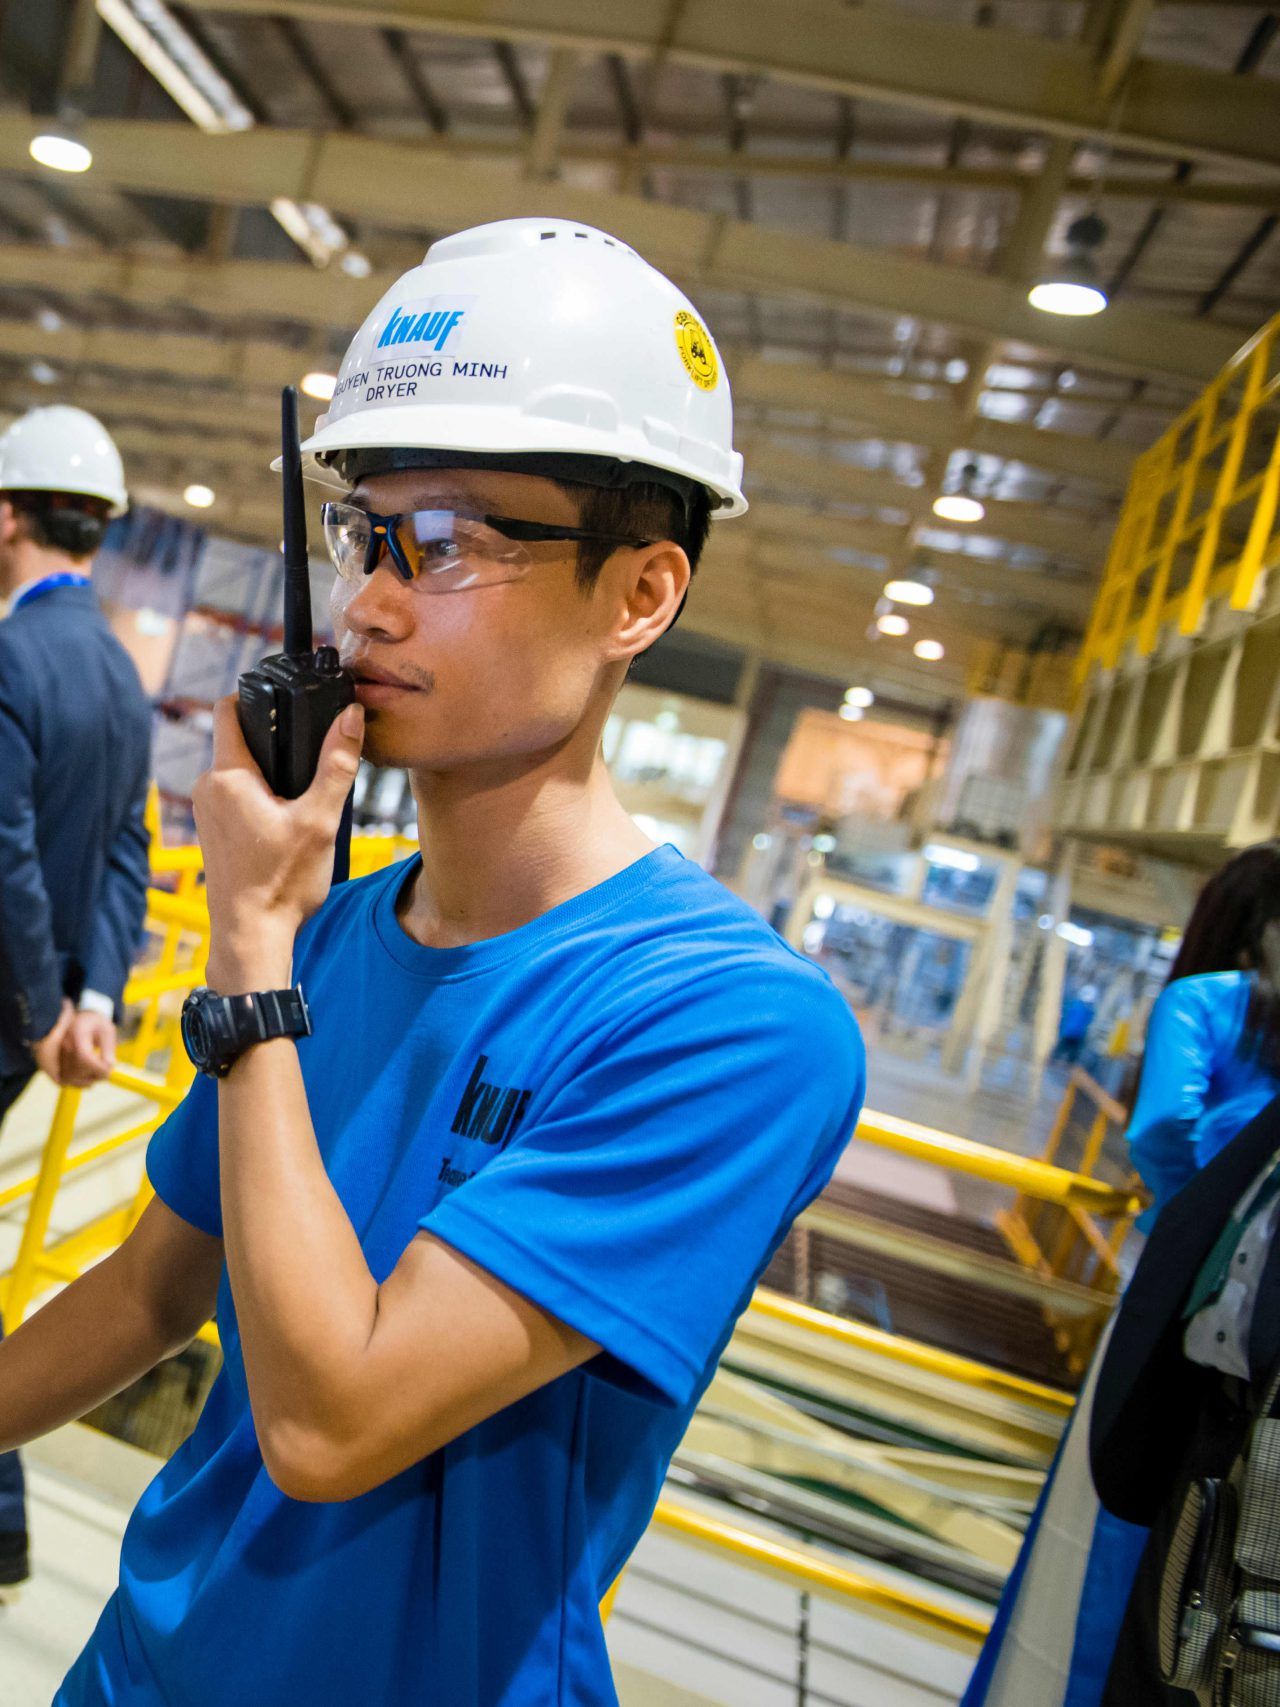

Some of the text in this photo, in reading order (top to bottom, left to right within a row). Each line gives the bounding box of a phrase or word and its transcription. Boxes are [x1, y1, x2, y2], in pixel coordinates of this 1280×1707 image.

[377, 306, 465, 351] KNAUF
[376, 362, 442, 382] TRUONG
[452, 361, 508, 379] MINH
[366, 382, 418, 402] DRYER
[450, 1054, 533, 1151] KNUF
